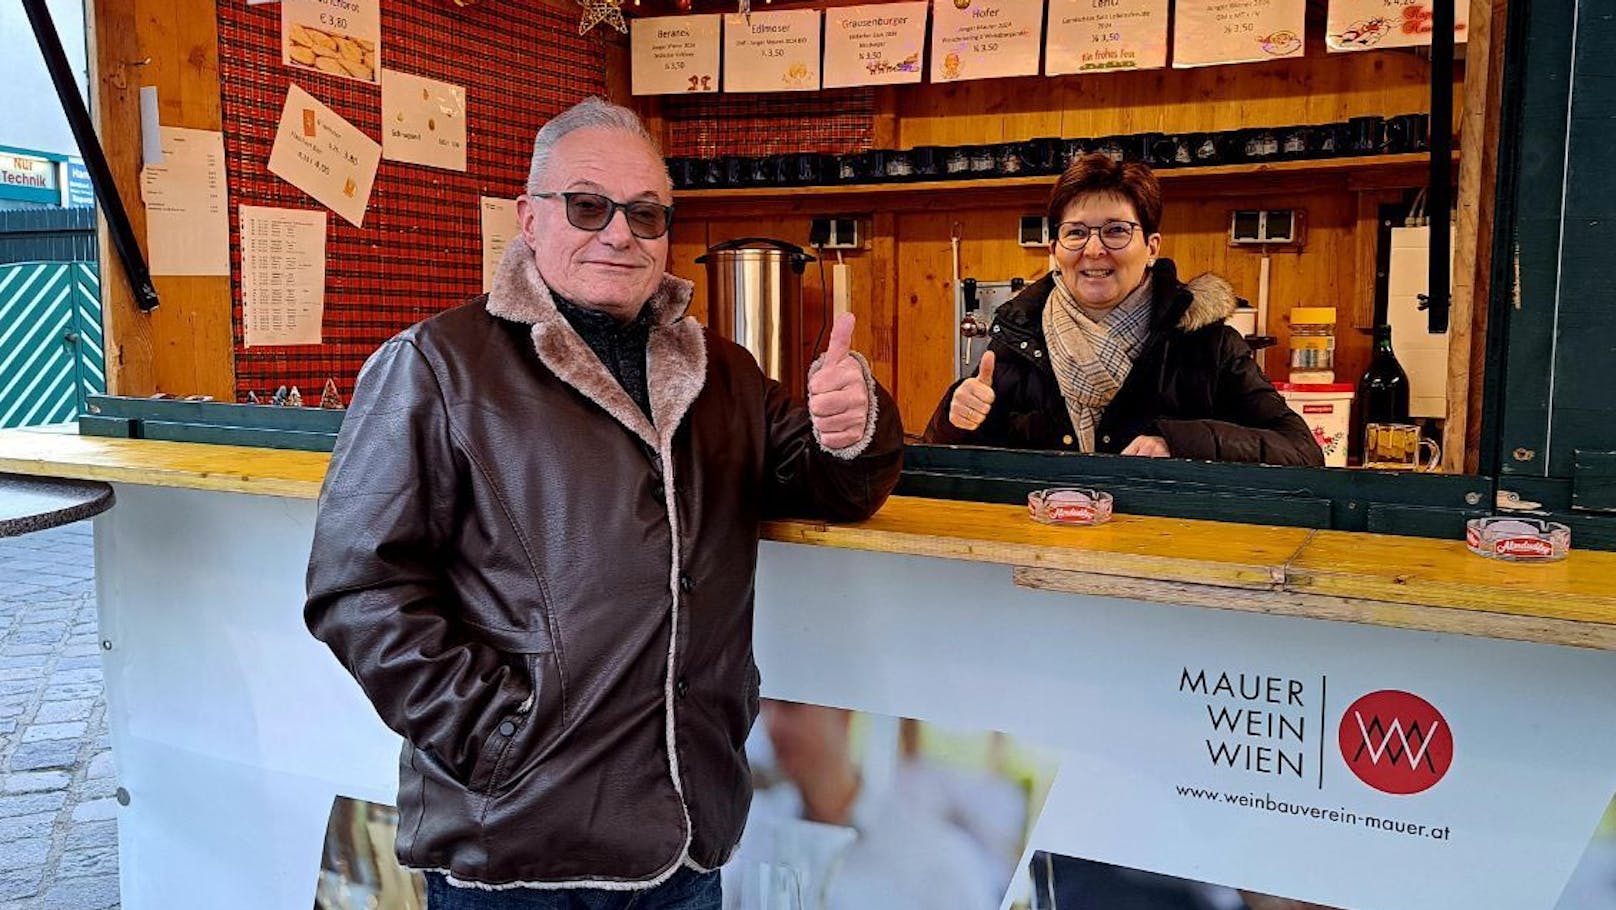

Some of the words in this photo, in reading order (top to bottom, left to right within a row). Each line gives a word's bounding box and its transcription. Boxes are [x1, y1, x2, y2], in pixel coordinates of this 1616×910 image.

[972, 7, 1000, 18] Hofer
[752, 24, 790, 34] Edlmoser
[842, 17, 908, 29] Grausenburger
[1233, 23, 1254, 33] 3,50
[768, 48, 785, 57] 3,50
[1095, 47, 1118, 60] frohes
[1, 170, 46, 188] Technik
[1496, 540, 1552, 556] Almdudler
[1179, 667, 1304, 707] MAUER
[1207, 704, 1304, 742] WEIN
[1206, 739, 1303, 778] WIEN
[1176, 785, 1451, 841] www.weinbauverein-mauer.at
